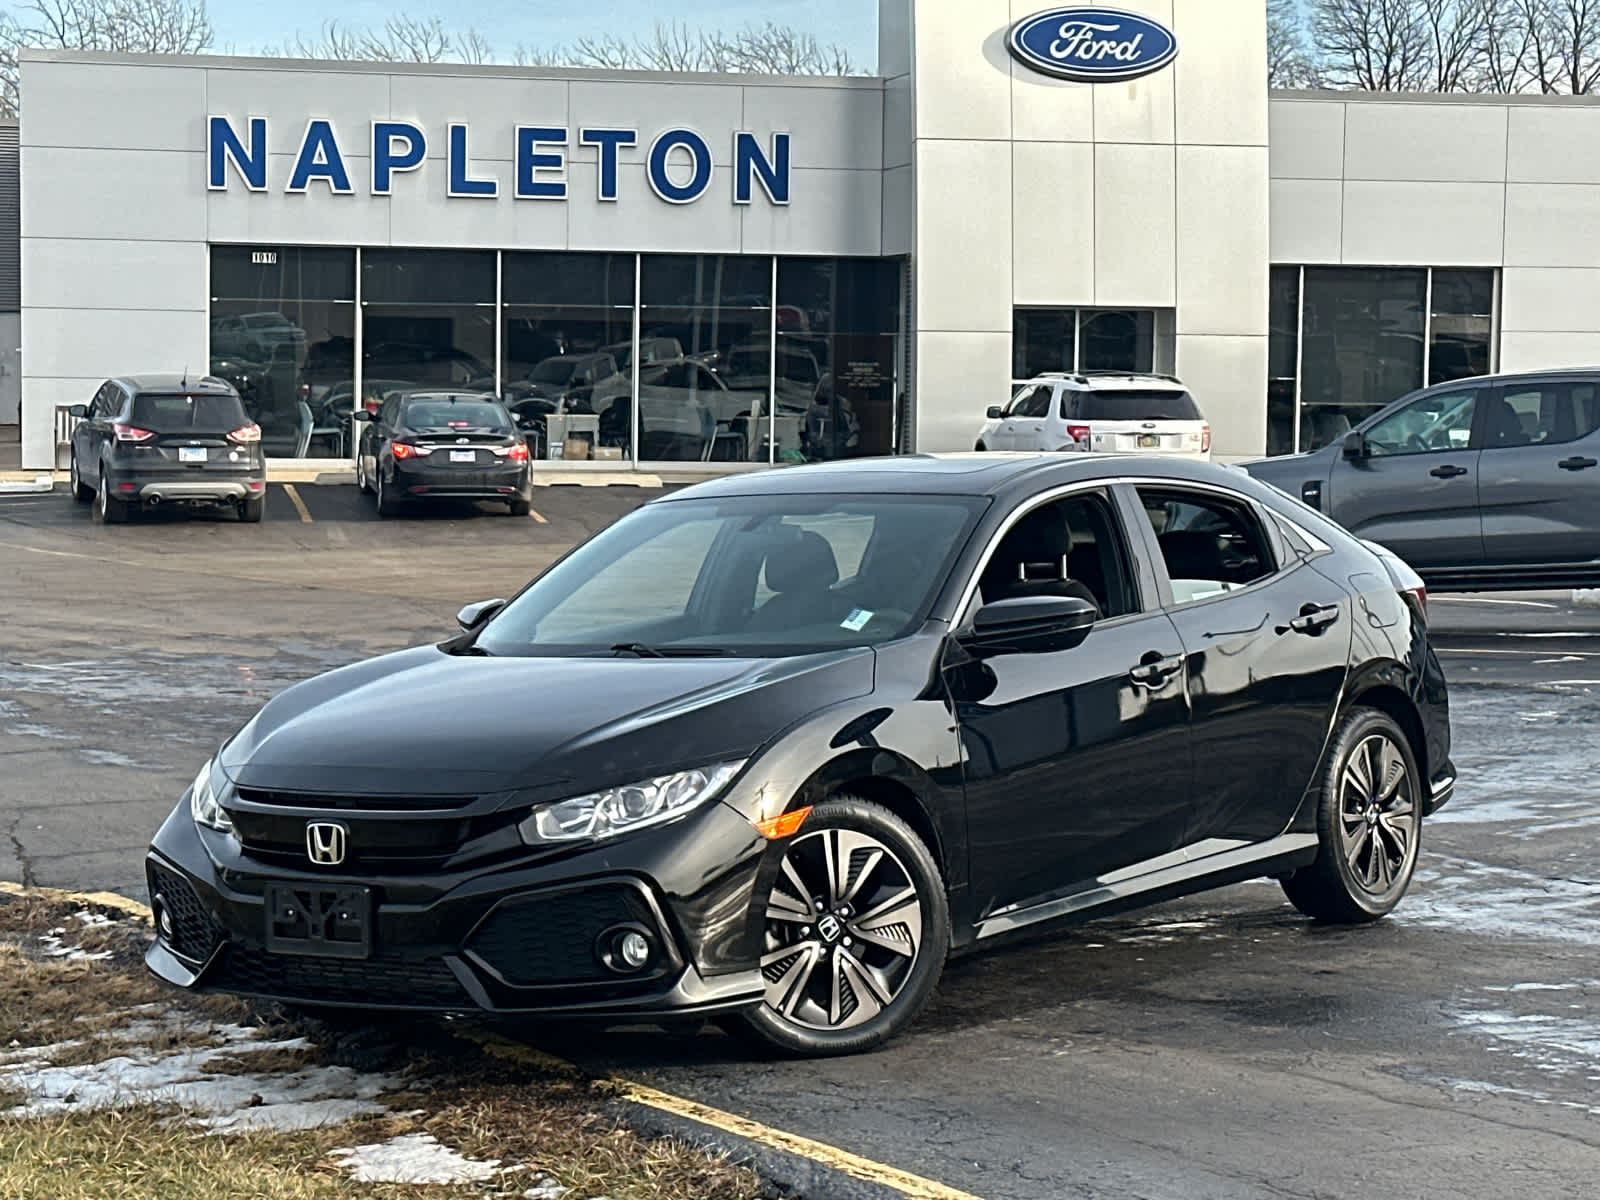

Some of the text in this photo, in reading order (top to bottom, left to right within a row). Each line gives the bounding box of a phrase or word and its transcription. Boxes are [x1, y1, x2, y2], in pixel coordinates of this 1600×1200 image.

[1050, 21, 1144, 61] Ford
[206, 115, 792, 206] NAPLETON
[251, 251, 277, 264] 1010
